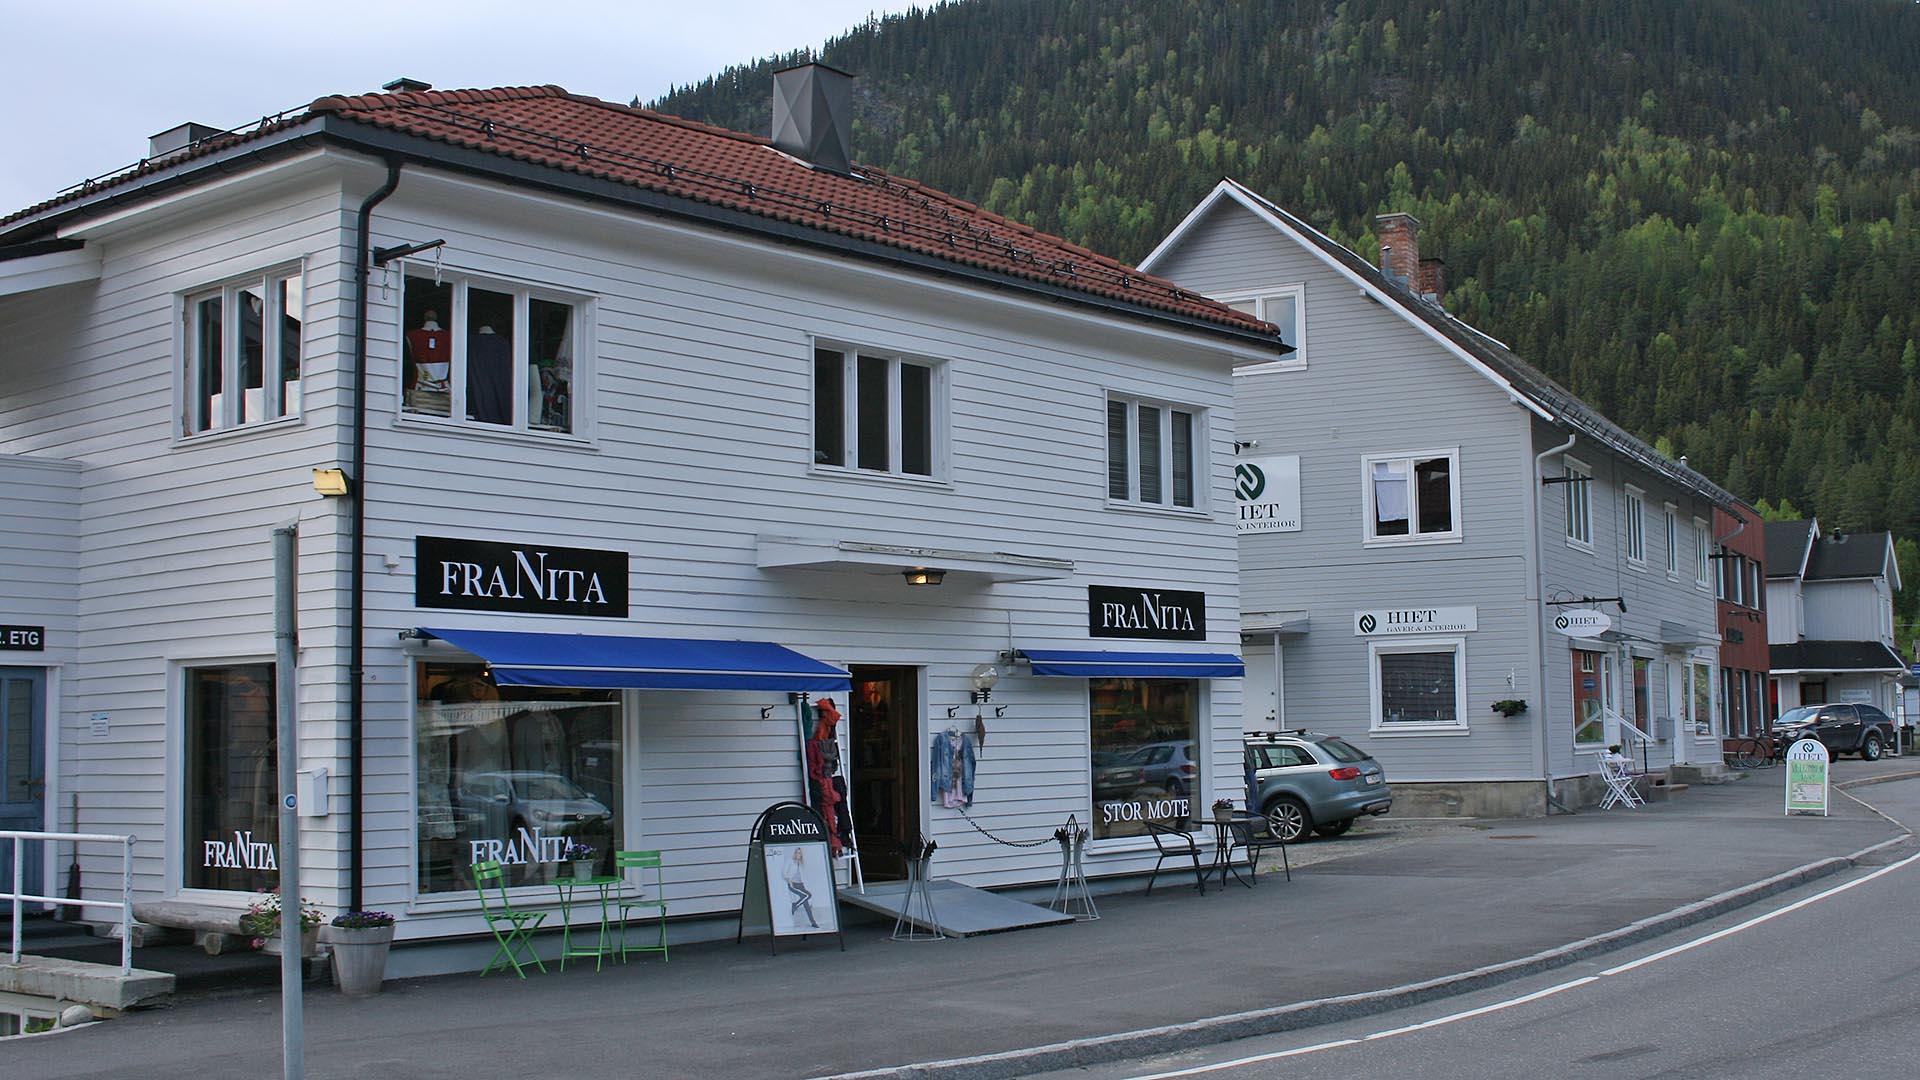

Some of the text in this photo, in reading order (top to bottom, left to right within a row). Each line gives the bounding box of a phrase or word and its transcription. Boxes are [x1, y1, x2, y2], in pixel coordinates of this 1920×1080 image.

[1240, 503, 1280, 520] IET
[1246, 520, 1296, 530] INTERIOR
[1387, 610, 1437, 624] HIET
[1424, 624, 1467, 632] INTERIOR
[10, 631, 39, 646] ETG
[1103, 799, 1190, 823] STOR MOTE
